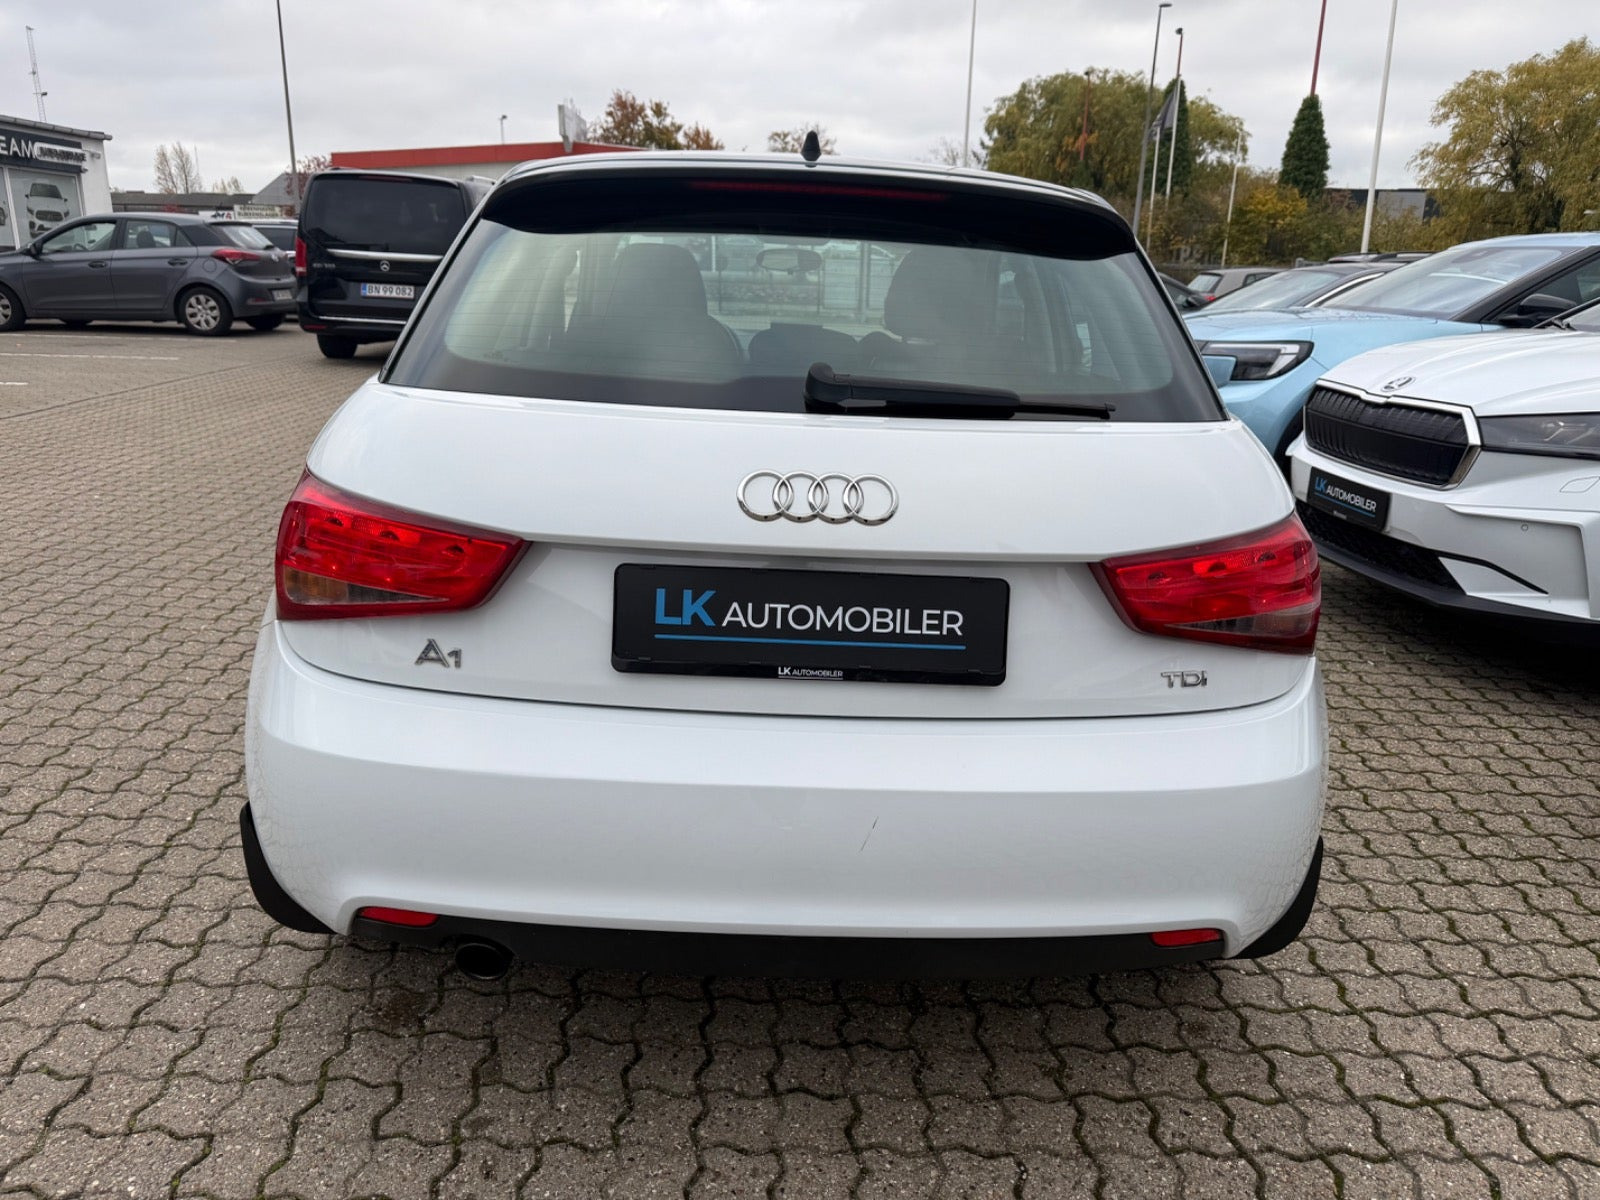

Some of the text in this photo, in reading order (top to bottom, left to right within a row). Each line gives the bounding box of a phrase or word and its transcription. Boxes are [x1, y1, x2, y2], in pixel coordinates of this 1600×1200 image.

[368, 285, 412, 296] BN 99 082
[1315, 476, 1377, 512] LK AUTOMOBILER
[655, 587, 964, 637] LK AUTOMOBILER
[414, 638, 462, 669] A1
[778, 666, 843, 677] LK AUTOMOBILER
[1160, 670, 1208, 689] TDI
